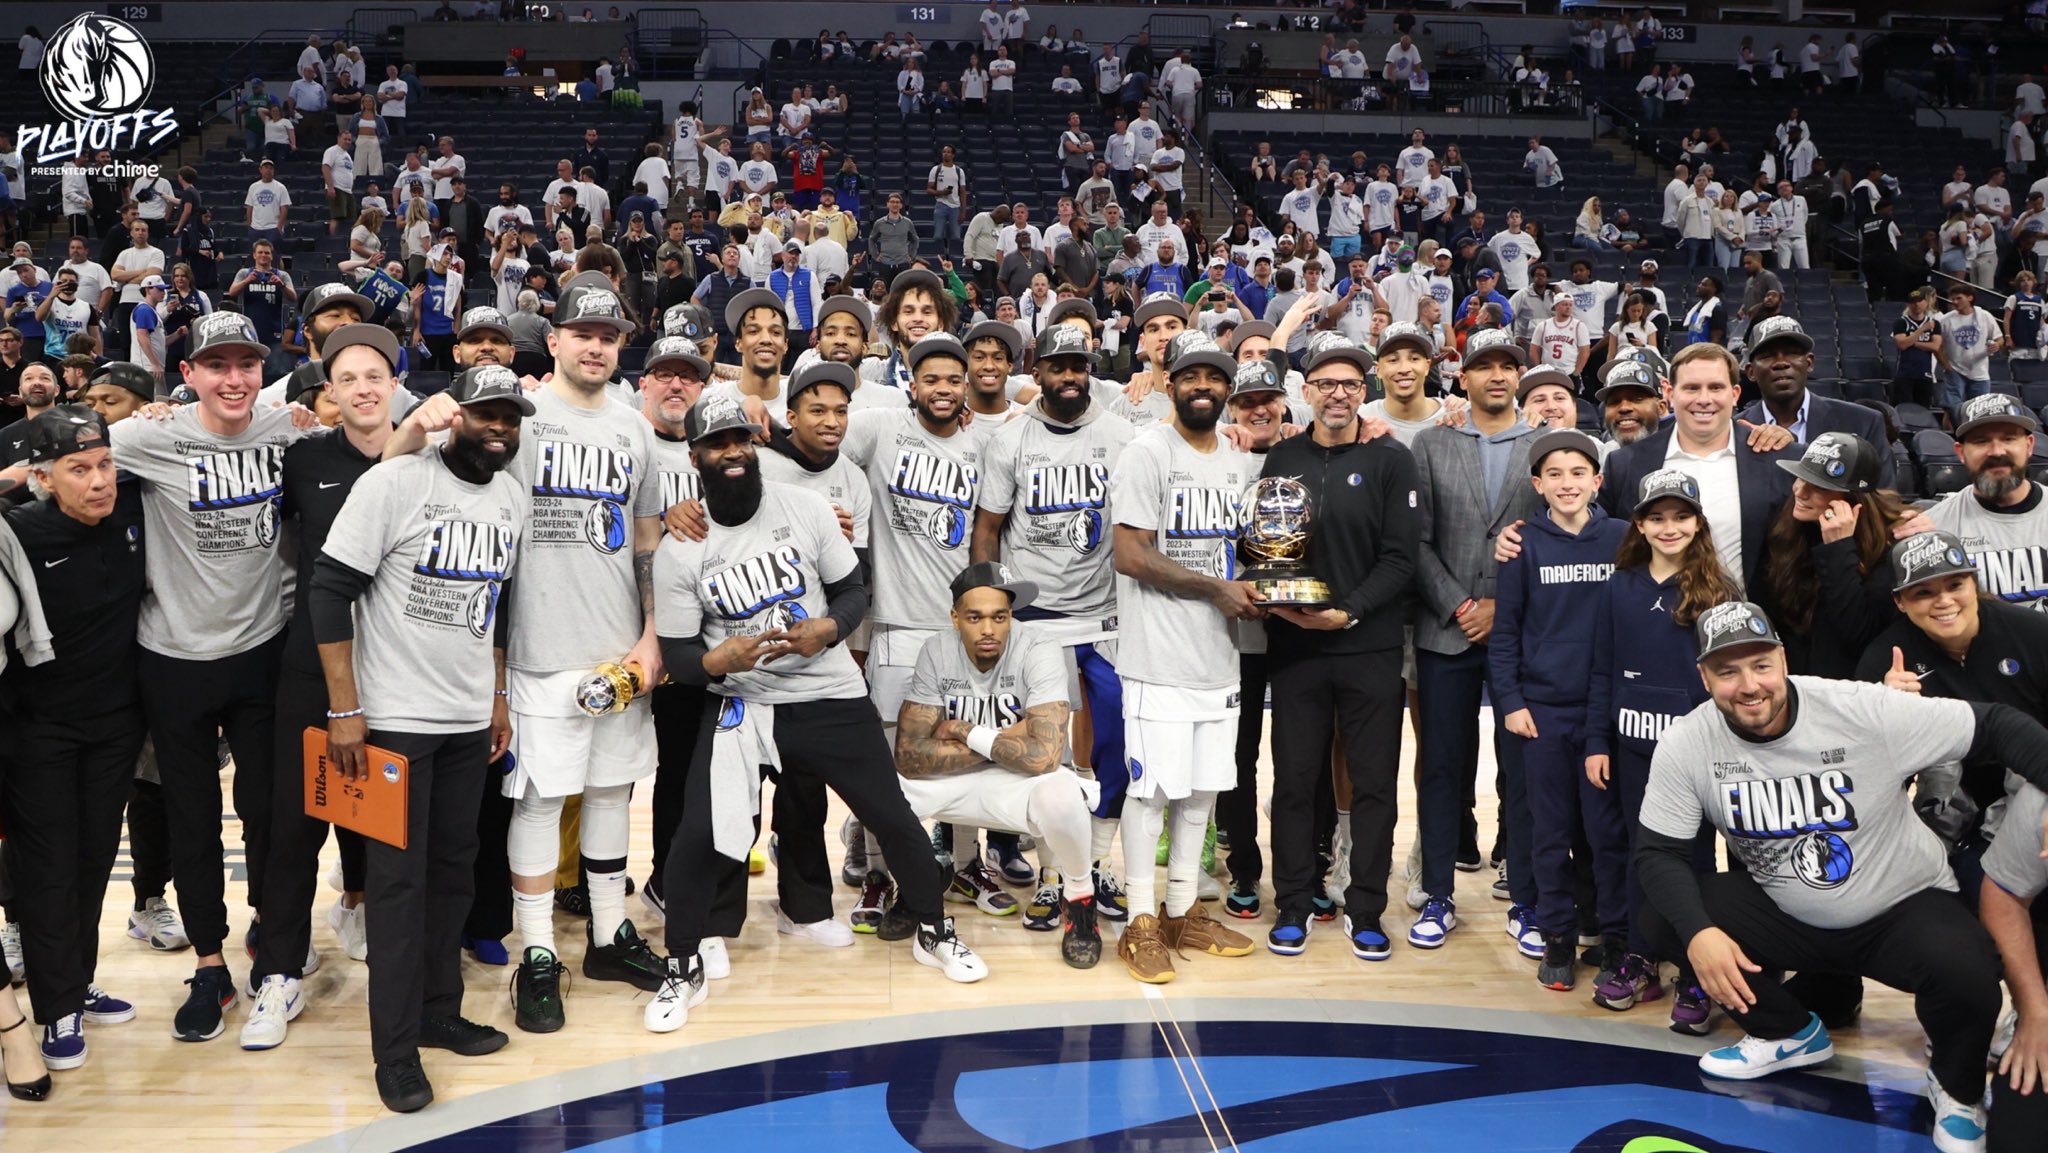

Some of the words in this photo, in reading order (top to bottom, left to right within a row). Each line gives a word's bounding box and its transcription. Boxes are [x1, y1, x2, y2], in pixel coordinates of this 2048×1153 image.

[122, 7, 148, 19] 129
[910, 7, 936, 20] 131
[1661, 27, 1685, 40] 133
[680, 127, 689, 138] 5
[695, 245, 703, 255] 5
[1355, 303, 1364, 317] 5
[1544, 335, 1576, 347] GEORGIA
[1552, 345, 1563, 360] 5
[540, 422, 568, 437] Finals
[185, 445, 285, 502] FINALS
[535, 440, 631, 496] FINALS
[890, 449, 979, 502] FINALS
[1026, 463, 1110, 507] FINALS
[533, 498, 562, 507] 2023-24
[533, 509, 548, 518] NBA
[550, 509, 584, 519] WESTERN
[214, 517, 252, 530] WESTERN
[533, 519, 579, 529] CONFERENCE
[196, 528, 249, 540] CONFERENCE
[533, 530, 577, 539] CHAMPIONS
[197, 539, 247, 550] CHAMPIONS
[416, 520, 513, 576] FINALS
[1166, 540, 1193, 549] 2023-24
[1166, 550, 1180, 558] NBA
[1181, 550, 1211, 559] WESTERN
[1900, 535, 1948, 584] Finals
[1928, 552, 1946, 567] 2024
[1540, 563, 1616, 584] MAVERICK
[1967, 545, 2048, 596] INAL
[412, 574, 446, 587] 2023-24
[700, 545, 804, 617] FINALS
[410, 584, 427, 595] NBA
[429, 586, 468, 601] WESTERN
[408, 593, 461, 612] CONFERENCE
[405, 603, 455, 622] CHAMPIONS
[1703, 604, 1753, 650] Finals
[1729, 620, 1748, 633] 2024
[947, 679, 972, 692] Finals
[944, 693, 1022, 729] FINALS
[1619, 708, 1684, 741] MAV
[1721, 761, 1754, 780] Finals
[314, 755, 327, 807] Wilson
[1720, 769, 1853, 834] FINALS
